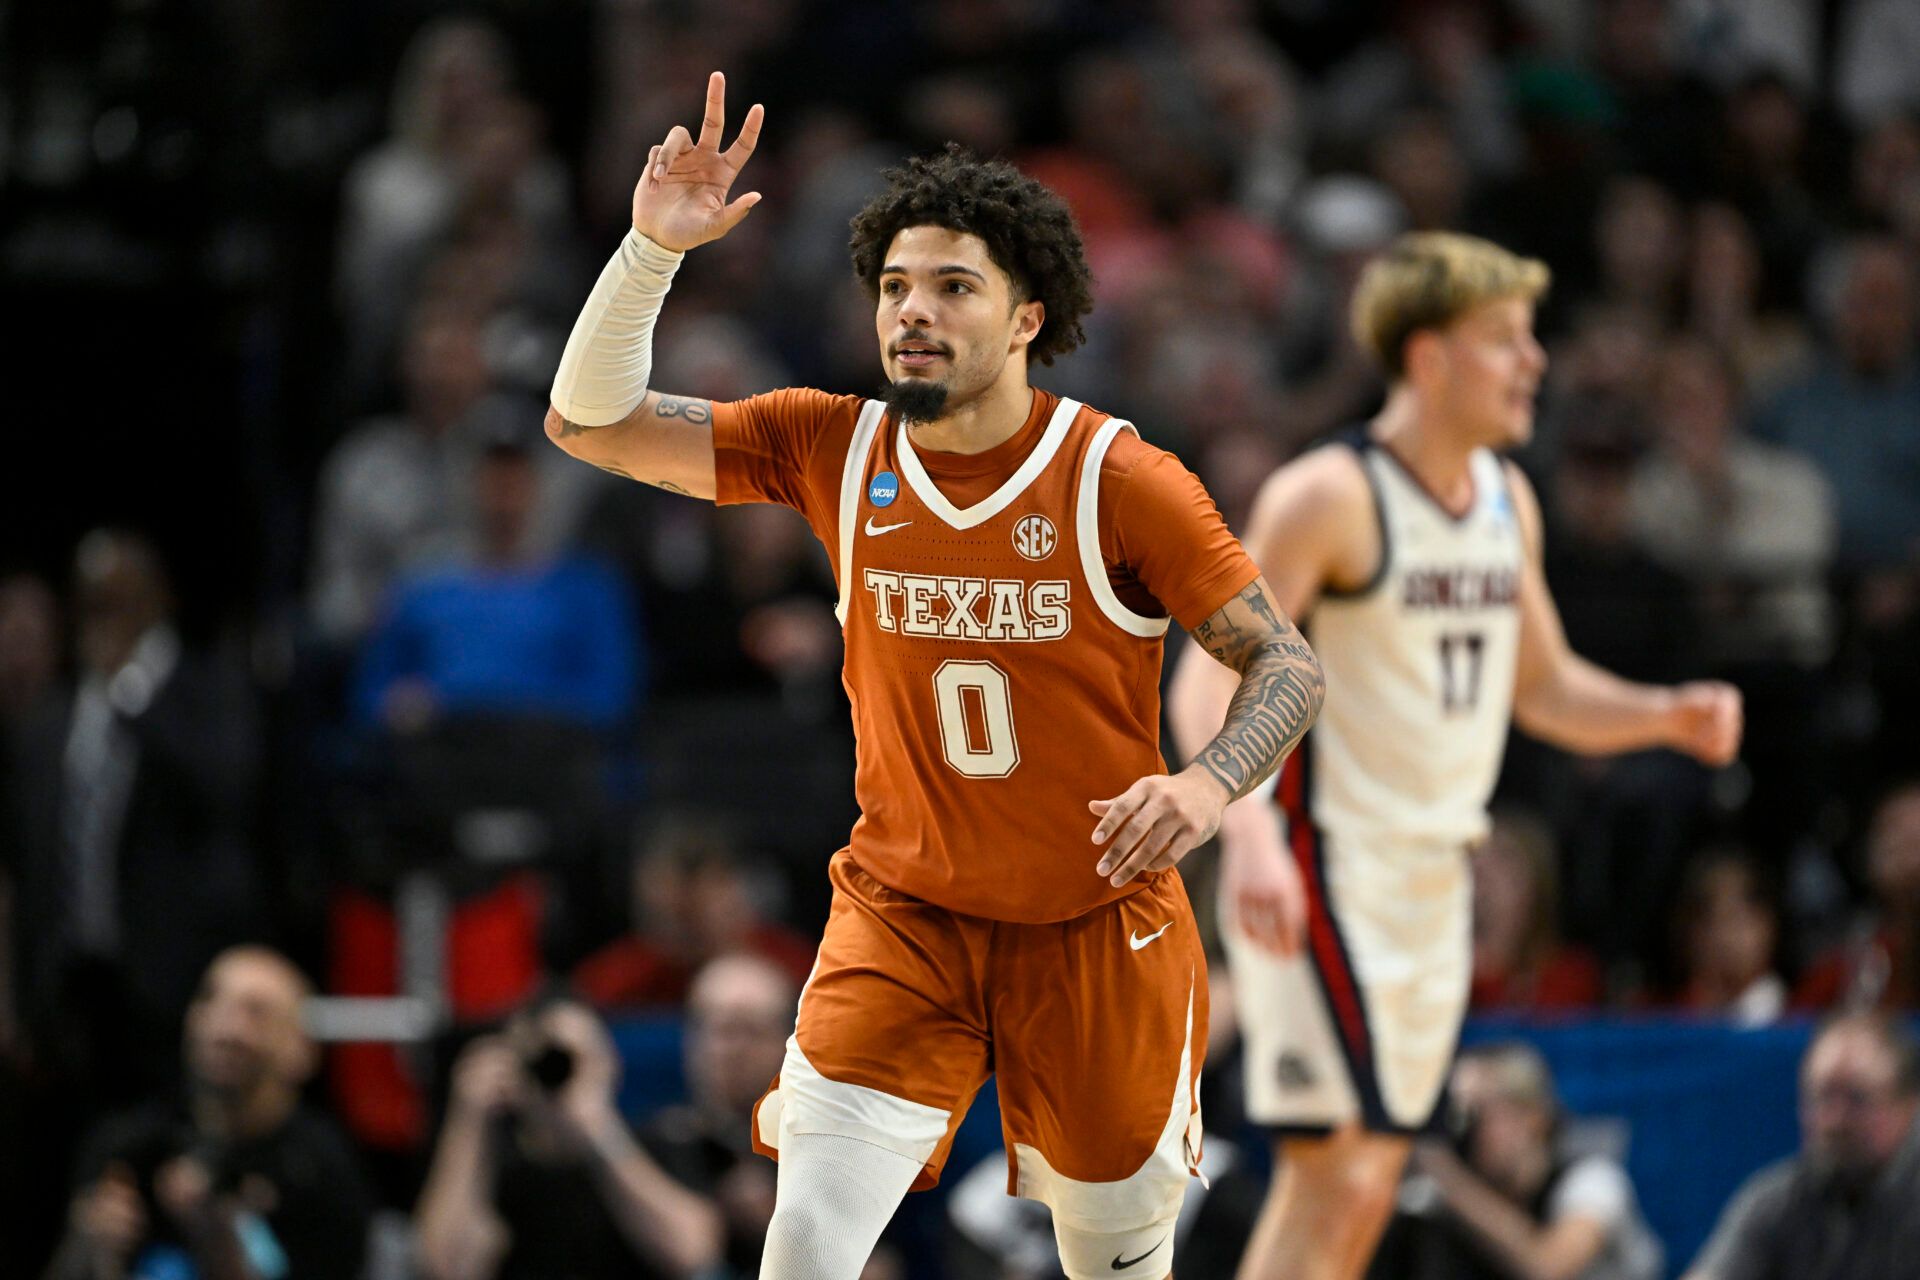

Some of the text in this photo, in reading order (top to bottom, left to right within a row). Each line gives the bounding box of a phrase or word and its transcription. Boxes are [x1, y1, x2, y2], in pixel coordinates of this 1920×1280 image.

[871, 487, 895, 499] NCAA
[1016, 517, 1054, 556] SEC
[863, 567, 1071, 642] TEXAS
[932, 658, 1021, 779] 0
